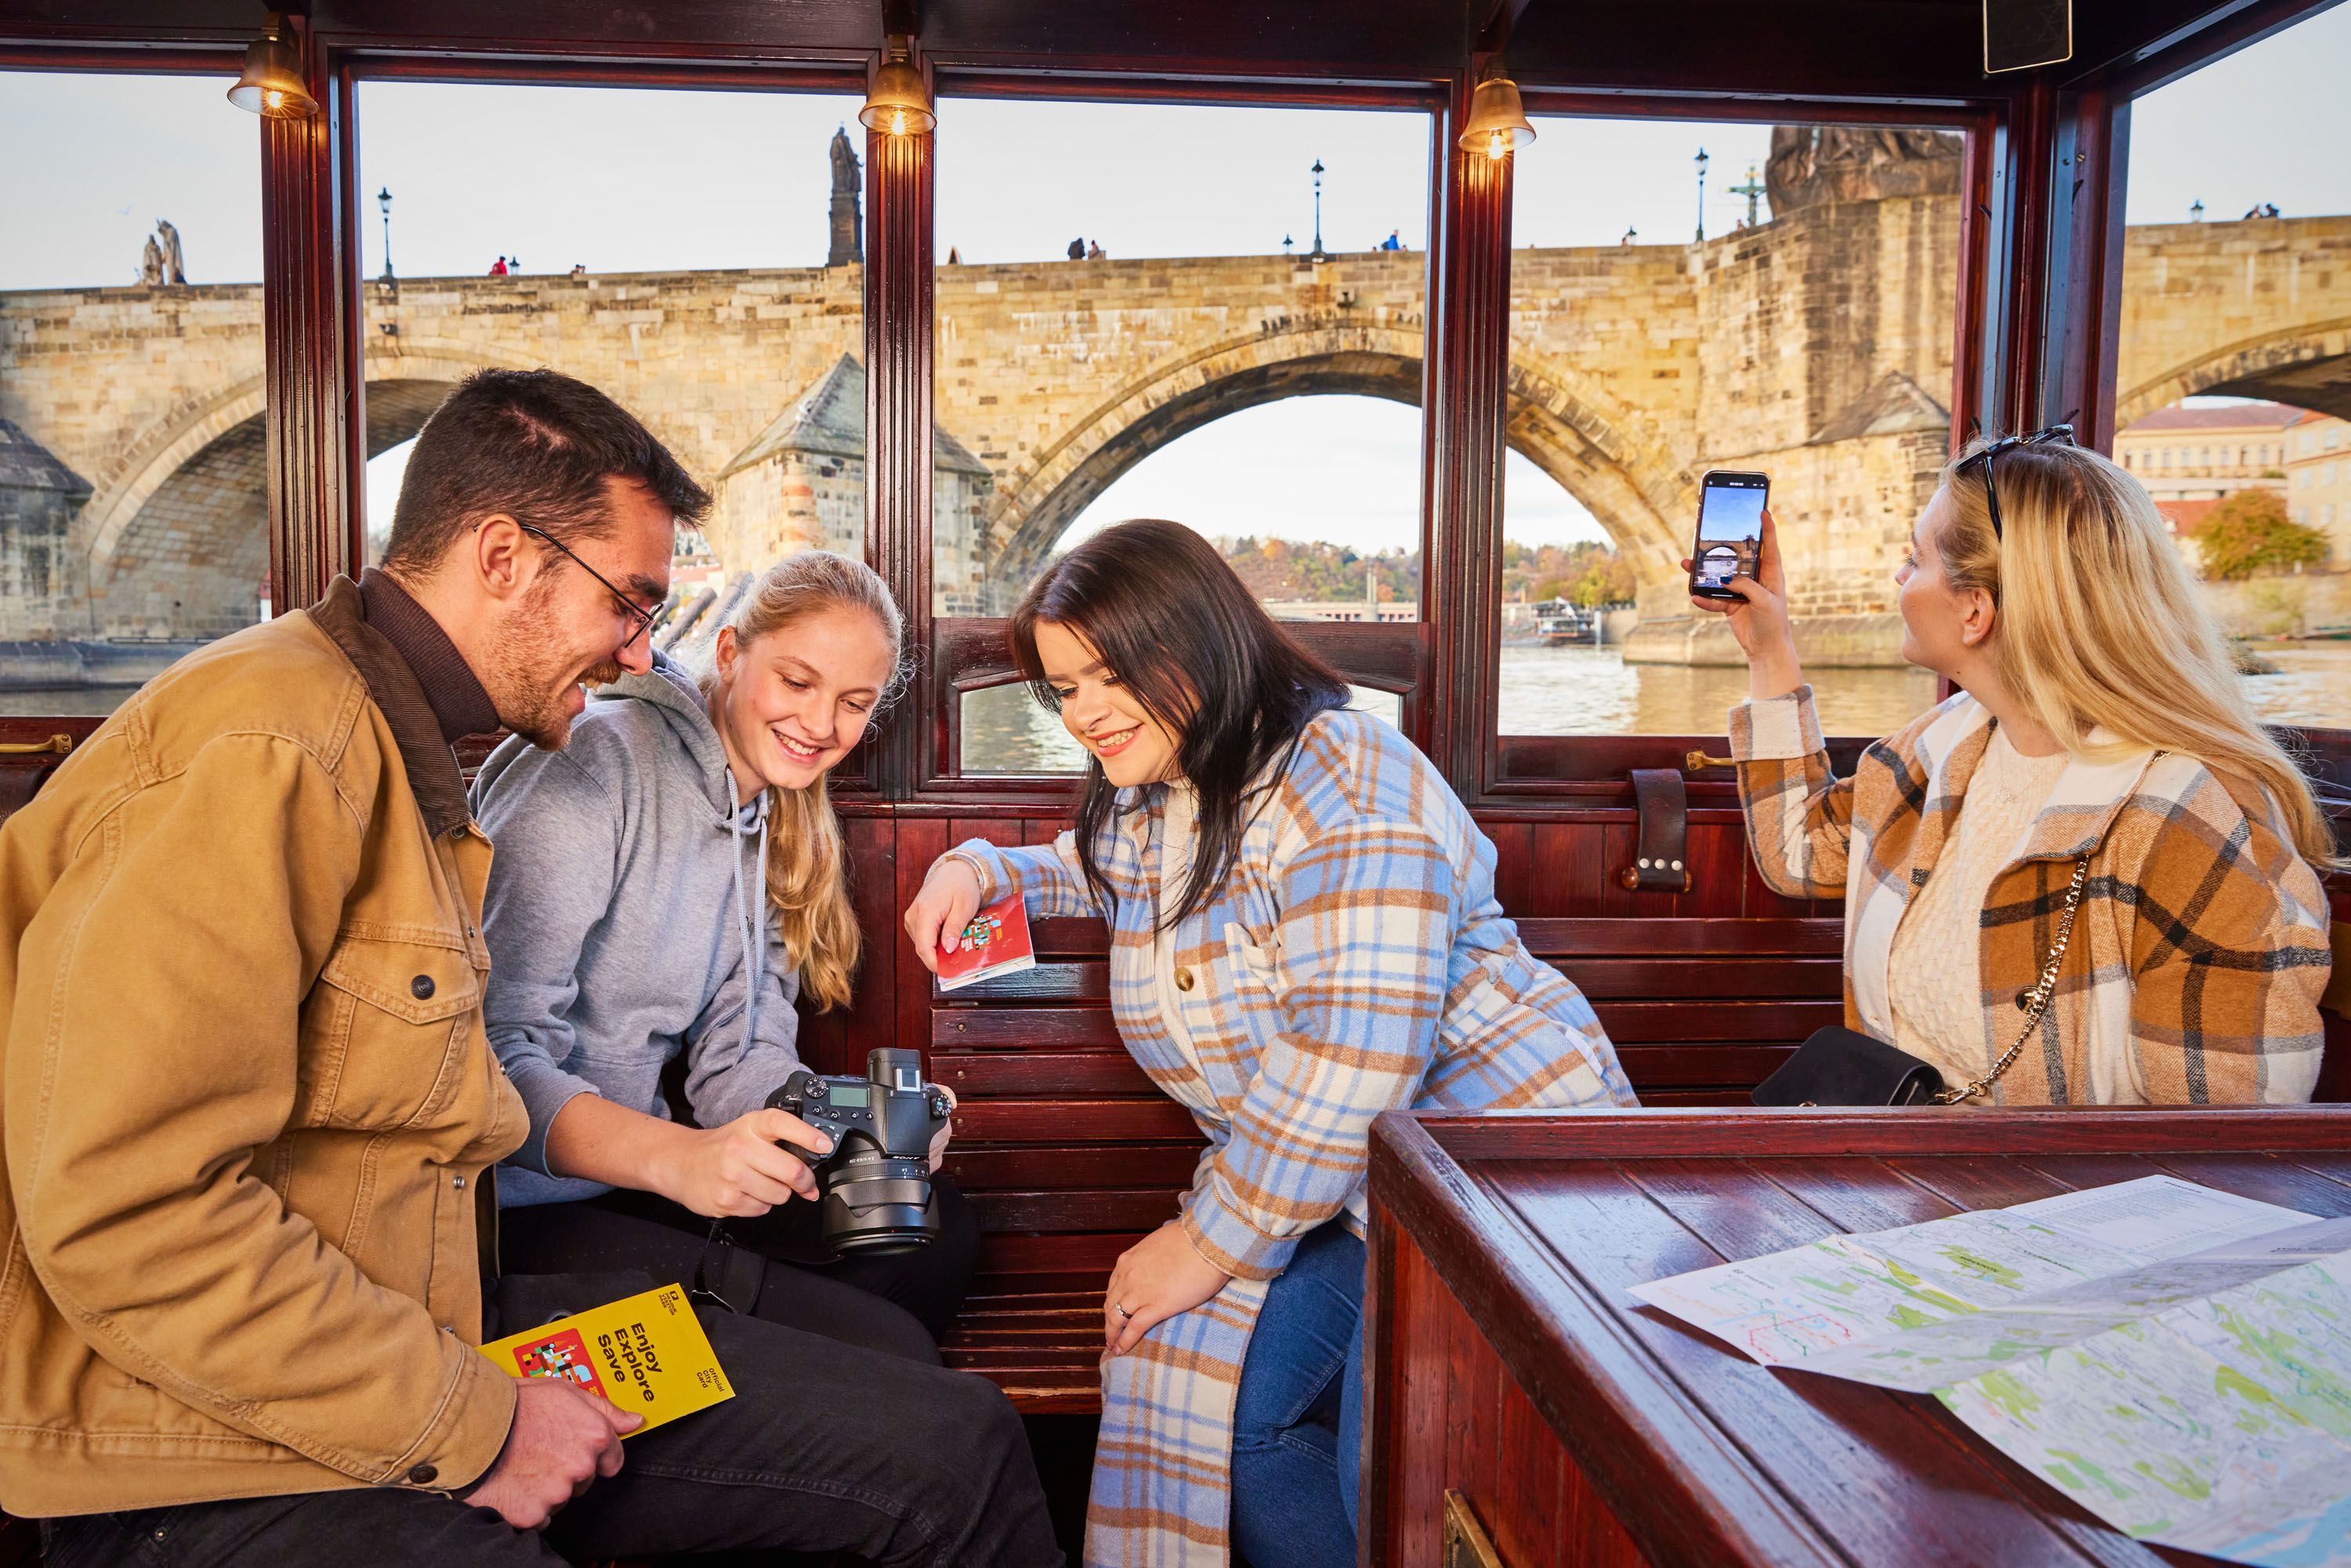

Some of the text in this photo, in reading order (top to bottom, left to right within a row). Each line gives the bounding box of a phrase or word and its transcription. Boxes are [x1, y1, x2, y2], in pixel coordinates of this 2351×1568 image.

[662, 1293, 675, 1316] VISITOR
[665, 1292, 677, 1313] PRAGUE
[597, 1334, 625, 1383] Save
[630, 1322, 663, 1373] Enjoy
[614, 1328, 654, 1402] Explore
[703, 1370, 712, 1383] City
[697, 1372, 708, 1389] Card
[708, 1367, 725, 1392] Official
